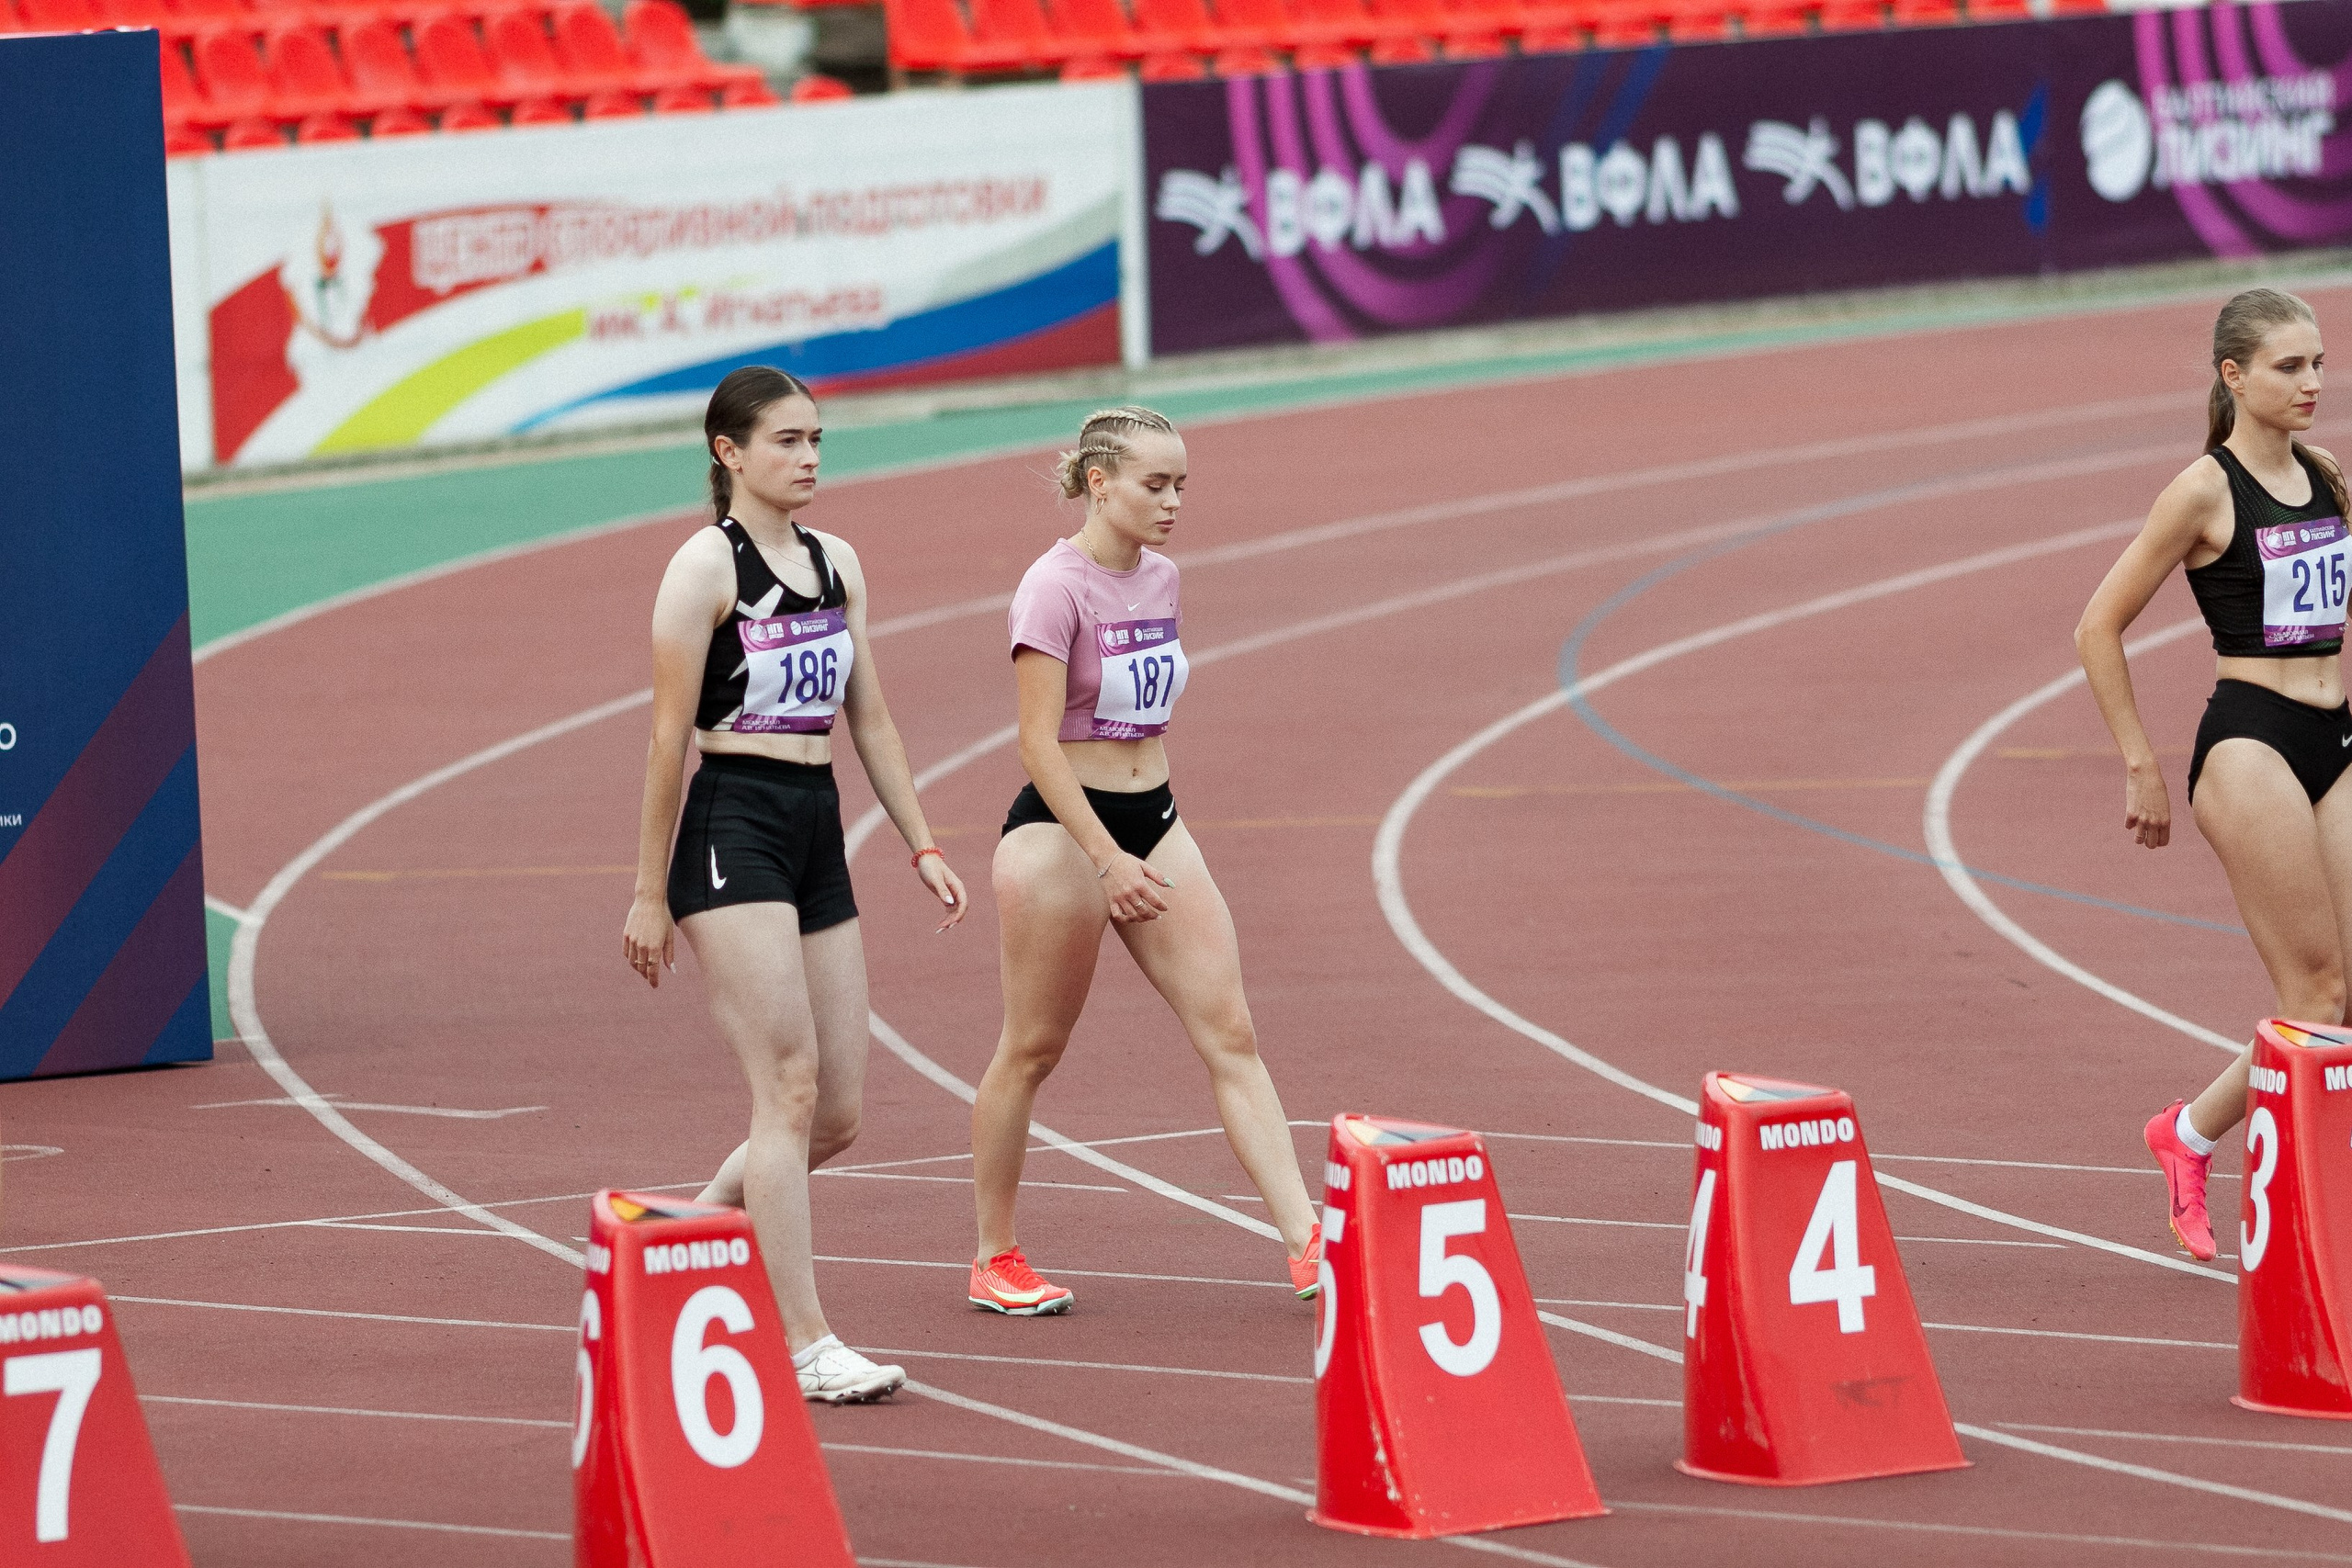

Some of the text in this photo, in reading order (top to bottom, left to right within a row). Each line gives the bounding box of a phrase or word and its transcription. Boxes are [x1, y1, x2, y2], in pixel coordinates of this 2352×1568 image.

[1266, 158, 1447, 257] ВФЛА
[1559, 130, 1739, 231] ВФЛА
[1854, 109, 2030, 207] ВФЛА
[2292, 553, 2346, 612] 215
[777, 648, 837, 704] 186
[1128, 655, 1174, 710] 187
[1386, 1156, 1484, 1190] MONDO
[1759, 1117, 1854, 1150] MONDO
[2240, 1106, 2278, 1272] 3
[644, 1238, 750, 1274] MONDO
[1317, 1206, 1346, 1378] 5
[1419, 1199, 1501, 1376] 5
[1684, 1168, 1716, 1339] 4
[1789, 1159, 1875, 1334] 4
[0, 1305, 103, 1343] MONDO
[672, 1286, 763, 1468] 6
[5, 1348, 102, 1542] 7
